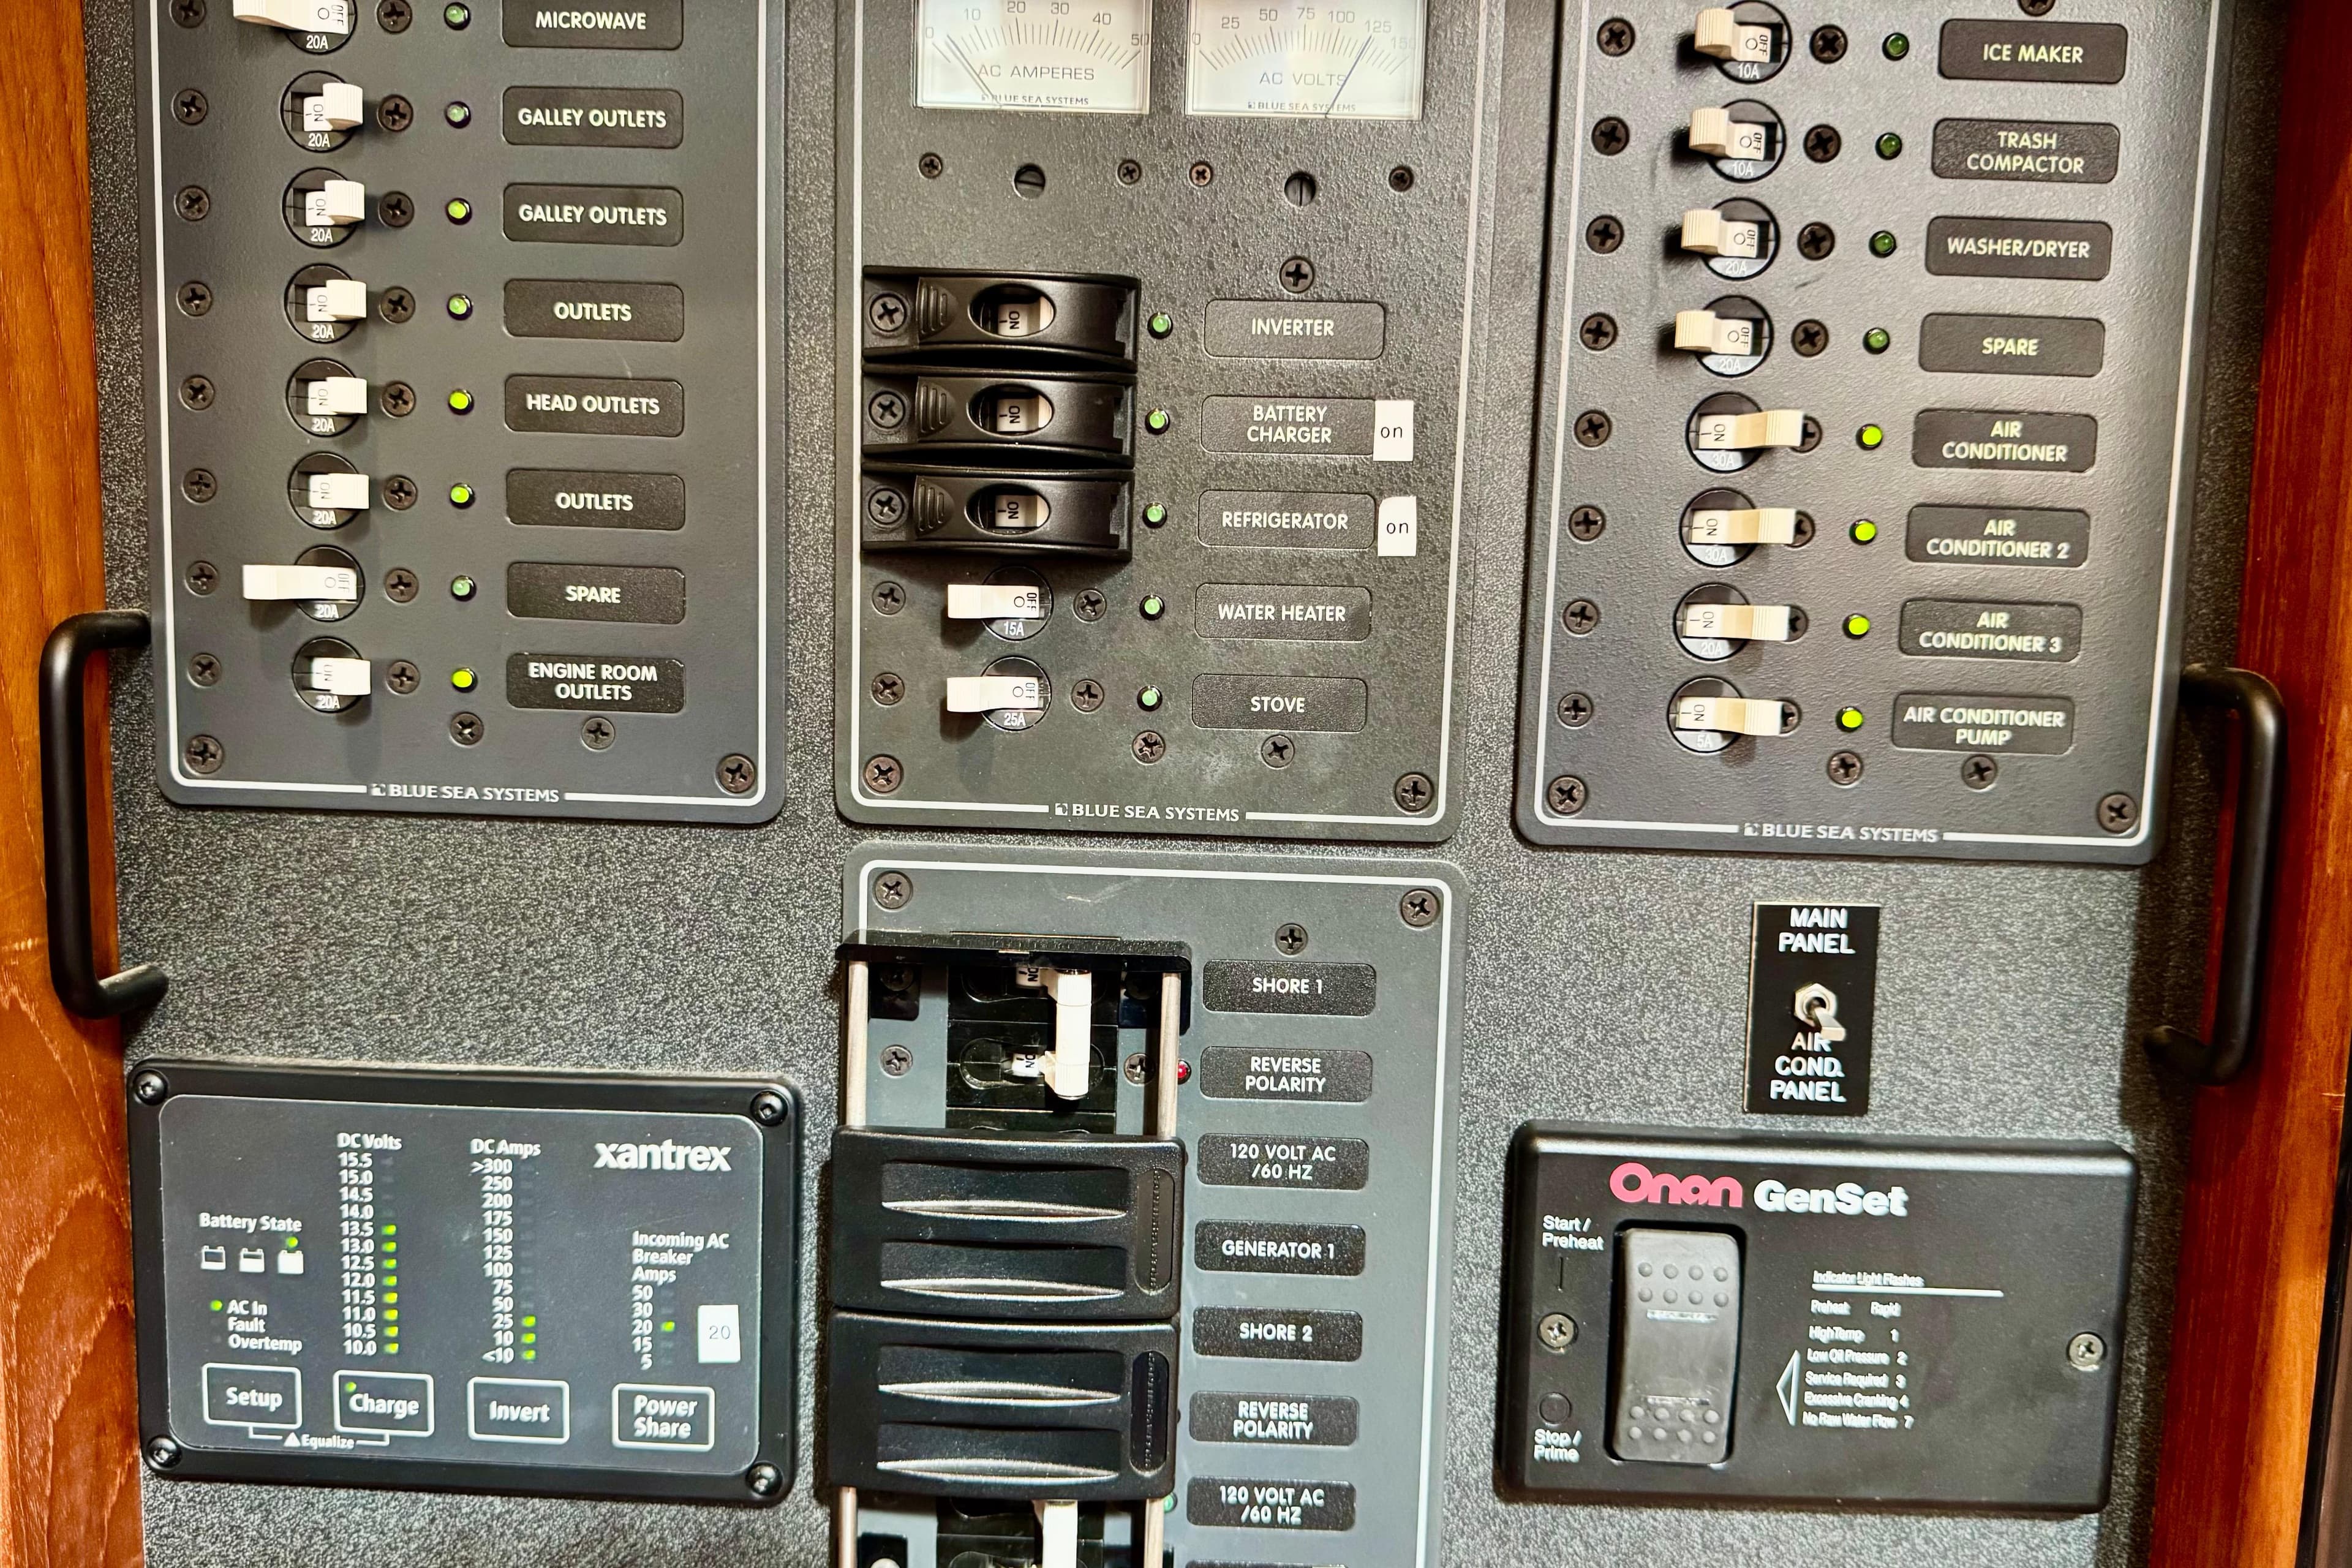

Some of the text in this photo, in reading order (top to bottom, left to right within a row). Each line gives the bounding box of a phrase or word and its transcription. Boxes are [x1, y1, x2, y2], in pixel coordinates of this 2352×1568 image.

[535, 11, 646, 29] MICROWAVE
[1259, 9, 1277, 21] 50
[1298, 7, 1314, 20] 75
[1328, 10, 1355, 23] 100
[1221, 17, 1240, 29] 25
[306, 35, 328, 49] 20A
[1983, 43, 2083, 63] ICE MAKER
[978, 65, 1094, 80] AC AMPERES
[1259, 72, 1347, 86] AC VOLTS
[518, 108, 666, 128] GALLEY OUTLETS
[1998, 131, 2057, 149] TRASH
[1967, 154, 2084, 173] COMPACTOR
[518, 204, 667, 225] GALLEY OUTLETS
[1947, 237, 2090, 258] WASHER/DRYER
[554, 301, 631, 322] OUTLETS
[1252, 318, 1334, 336] INVERTER
[1982, 337, 2038, 356] SPARE
[526, 393, 660, 415] HEAD OUTLETS
[1254, 405, 1327, 422] BATTERY
[1247, 426, 1332, 443] CHARGER
[1381, 426, 1403, 438] on
[1990, 420, 2023, 438] AIR
[1942, 442, 2068, 462] CONDITIONER
[556, 492, 633, 511] OUTLETS
[1223, 511, 1348, 530] REFRIGERATOR
[1387, 522, 1409, 533] on
[1983, 519, 2016, 537] AIR
[1926, 538, 2070, 559] CONDITIONER 2
[565, 586, 621, 604] SPARE
[1218, 604, 1346, 622] WATER HEATER
[1977, 611, 2008, 630] AIR
[1004, 622, 1024, 636] 15A
[1919, 631, 2062, 653] CONDITIONER 3
[529, 662, 658, 681] ENGINE ROOM
[555, 684, 632, 701] OUTLETS
[1251, 697, 1305, 713] STOVE
[1005, 712, 1026, 726] 25A
[1903, 707, 2065, 728] AIR CONDITIONER
[1956, 729, 2012, 746] PUMP
[1072, 804, 1239, 822] BLUE SEA SYSTEMS
[1790, 908, 1848, 929] MAIN
[1778, 932, 1856, 954] PANEL
[1253, 978, 1322, 993] SHORE 1
[1791, 1031, 1832, 1052] AIR
[1251, 1057, 1321, 1073] REVERSE
[1246, 1076, 1325, 1092] POLARITY
[1770, 1080, 1847, 1102] PANEL
[337, 1133, 402, 1150] DC Volts
[470, 1138, 541, 1159] DC Amps
[338, 1152, 372, 1168] 15.5
[593, 1139, 731, 1171] xantrex
[1231, 1144, 1336, 1161] 120 VOLT AC
[469, 1158, 513, 1175] >300
[1251, 1164, 1312, 1180] /60 HZ
[338, 1169, 373, 1185] 15.0
[481, 1175, 513, 1192] 250
[339, 1186, 373, 1202] 14.5
[1610, 1163, 1909, 1217] Onan GenSet
[481, 1193, 513, 1209] 200
[339, 1204, 374, 1219] 14.0
[483, 1210, 513, 1226] 175
[199, 1212, 302, 1233] Battery State
[339, 1221, 374, 1237] 13.5
[483, 1227, 513, 1244] 150
[632, 1231, 729, 1252] Incoming AC
[1542, 1232, 1604, 1251] Preheat
[340, 1238, 374, 1254] 13.0
[483, 1245, 513, 1261] 125
[1222, 1240, 1334, 1259] GENERATOR 1
[340, 1255, 375, 1271] 12.5
[631, 1248, 693, 1265] Breaker
[483, 1262, 513, 1278] 100
[631, 1266, 676, 1286] Amps
[1813, 1270, 1925, 1287] Indicator Light Flashes
[341, 1272, 375, 1287] 12.0
[492, 1280, 513, 1295] 75
[342, 1289, 375, 1305] 11.5
[631, 1284, 653, 1301] 50
[227, 1300, 268, 1315] AC In
[492, 1296, 513, 1312] 50
[631, 1302, 653, 1318] 30
[1811, 1299, 1901, 1317] Preheat Rapid
[342, 1306, 375, 1322] 11.0
[492, 1313, 513, 1329] 25
[227, 1316, 266, 1333] Fault
[342, 1322, 376, 1339] 10.5
[631, 1319, 653, 1336] 20
[709, 1325, 731, 1340] 20
[1239, 1322, 1313, 1342] SHORE 2
[228, 1333, 303, 1355] Overtemp
[493, 1330, 514, 1346] 10
[632, 1336, 653, 1353] 15
[343, 1340, 377, 1356] 10.0
[482, 1347, 514, 1363] <10
[641, 1354, 653, 1371] 5
[1807, 1348, 1829, 1363] Low
[1845, 1349, 1890, 1365] Pressure
[1897, 1351, 1909, 1366] 2
[1805, 1371, 1907, 1389] Service Required 3
[226, 1387, 282, 1412] Setup
[349, 1393, 419, 1420] Charge
[633, 1394, 698, 1417] Power
[1804, 1391, 1910, 1412] Excessive Cranking 4
[489, 1400, 550, 1423] Invert
[1238, 1401, 1308, 1420] REVERSE
[633, 1417, 692, 1439] Share
[1233, 1420, 1313, 1439] POLARITY
[301, 1434, 355, 1450] Equalize
[1534, 1444, 1580, 1463] Prime
[1220, 1486, 1324, 1507] 120 VOLT AC
[1241, 1505, 1302, 1525] /60 HZ
